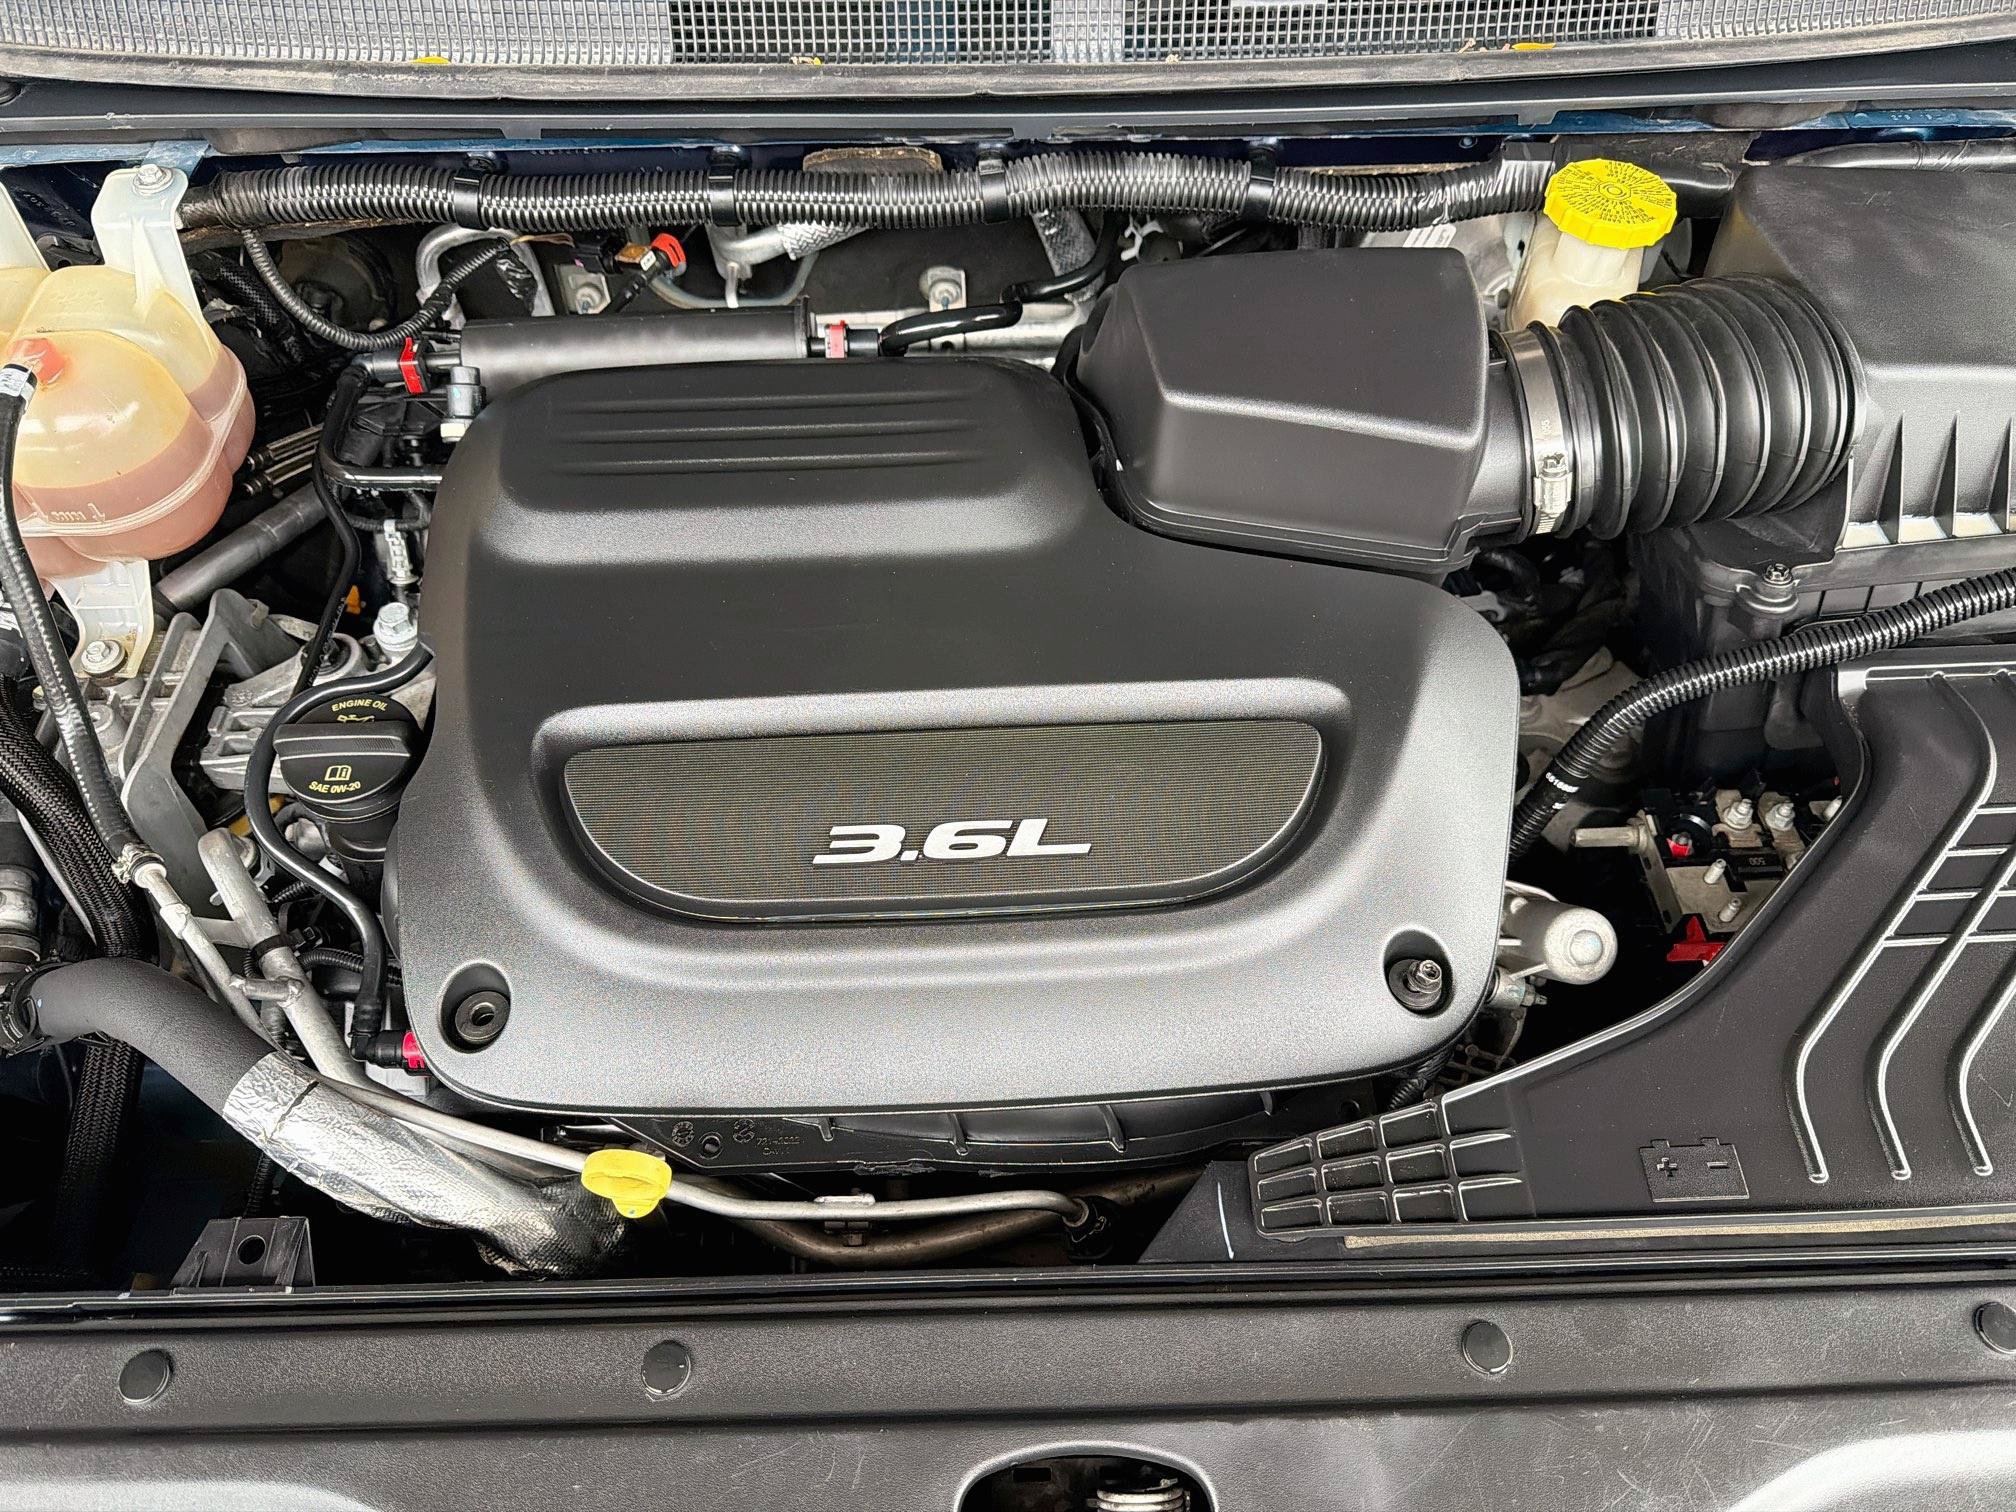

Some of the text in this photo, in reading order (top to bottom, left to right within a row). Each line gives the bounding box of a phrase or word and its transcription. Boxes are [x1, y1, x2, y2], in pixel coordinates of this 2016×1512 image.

[331, 699, 388, 712] ENGINE OIL
[308, 780, 361, 793] SAE 0W-20
[812, 818, 1092, 866] 3.6L
